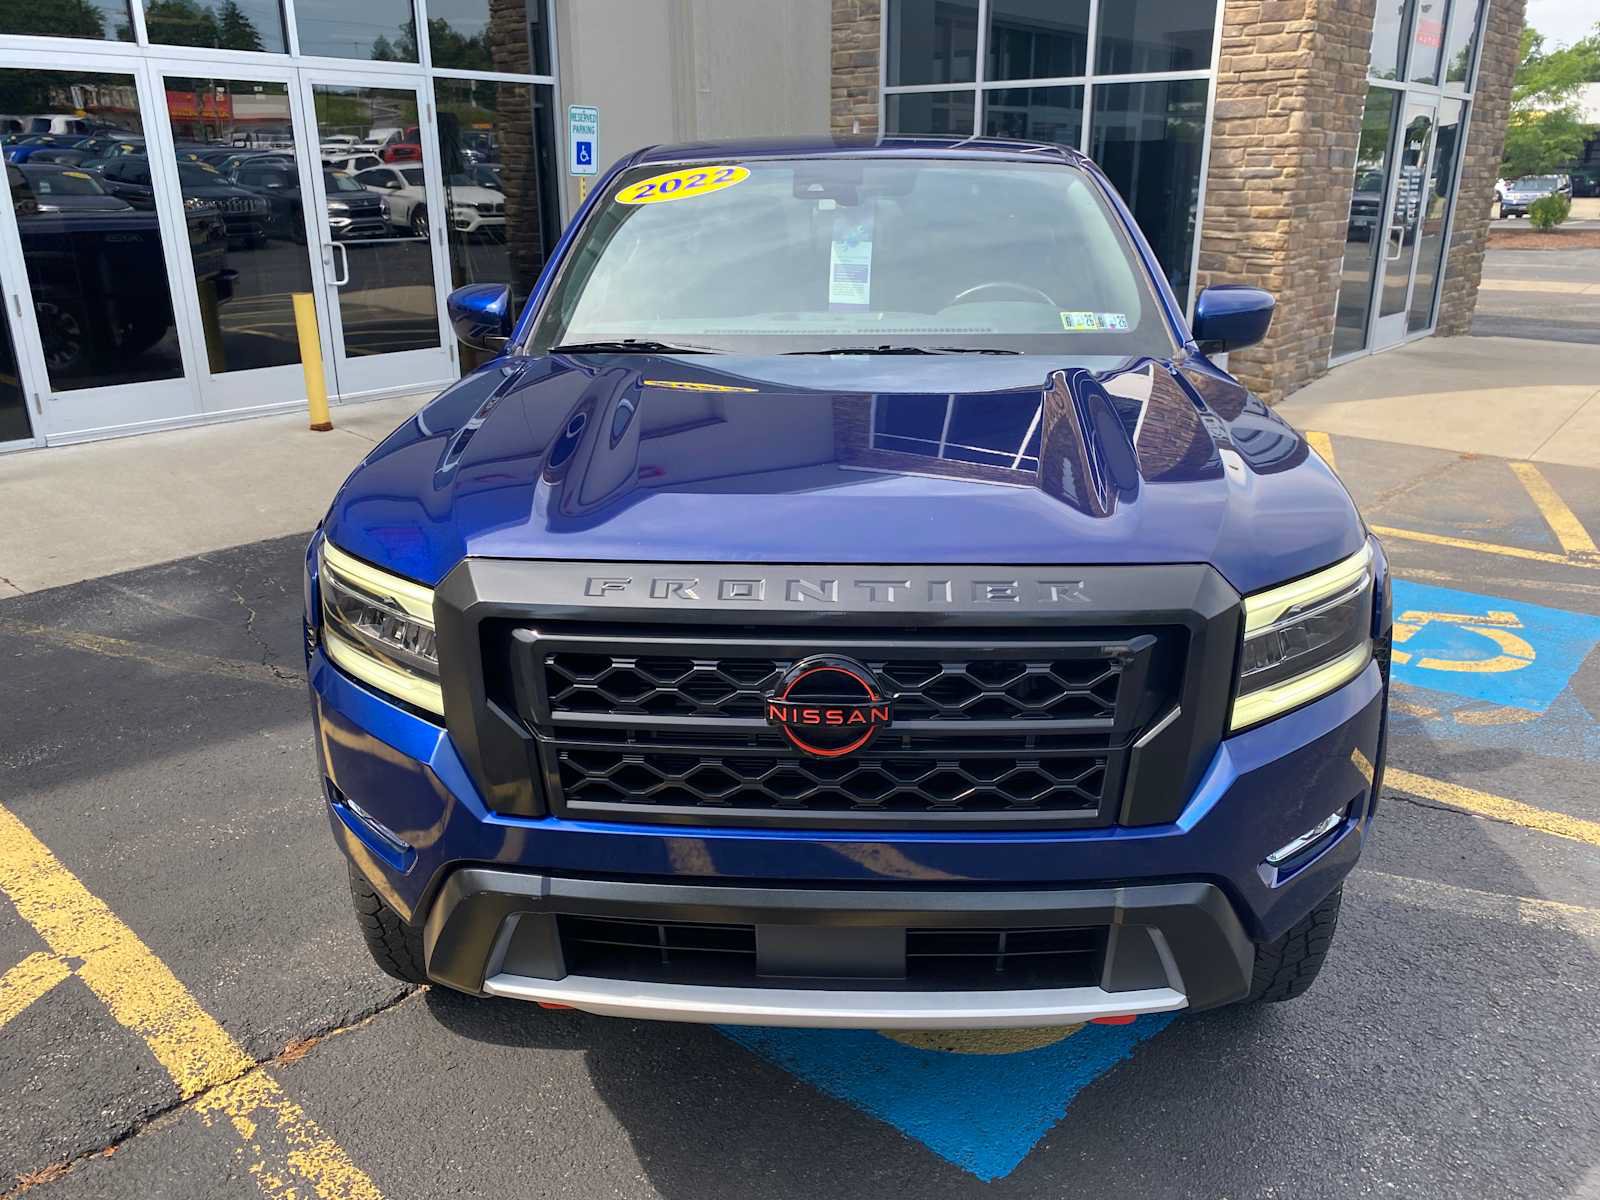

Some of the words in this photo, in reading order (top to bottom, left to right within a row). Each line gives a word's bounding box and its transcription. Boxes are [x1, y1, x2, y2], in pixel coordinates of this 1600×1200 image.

[570, 112, 596, 122] RESERVED
[572, 125, 595, 134] PARKING
[632, 168, 735, 200] 2022
[584, 577, 1092, 603] FRONTIER
[768, 704, 889, 725] NISSAN
